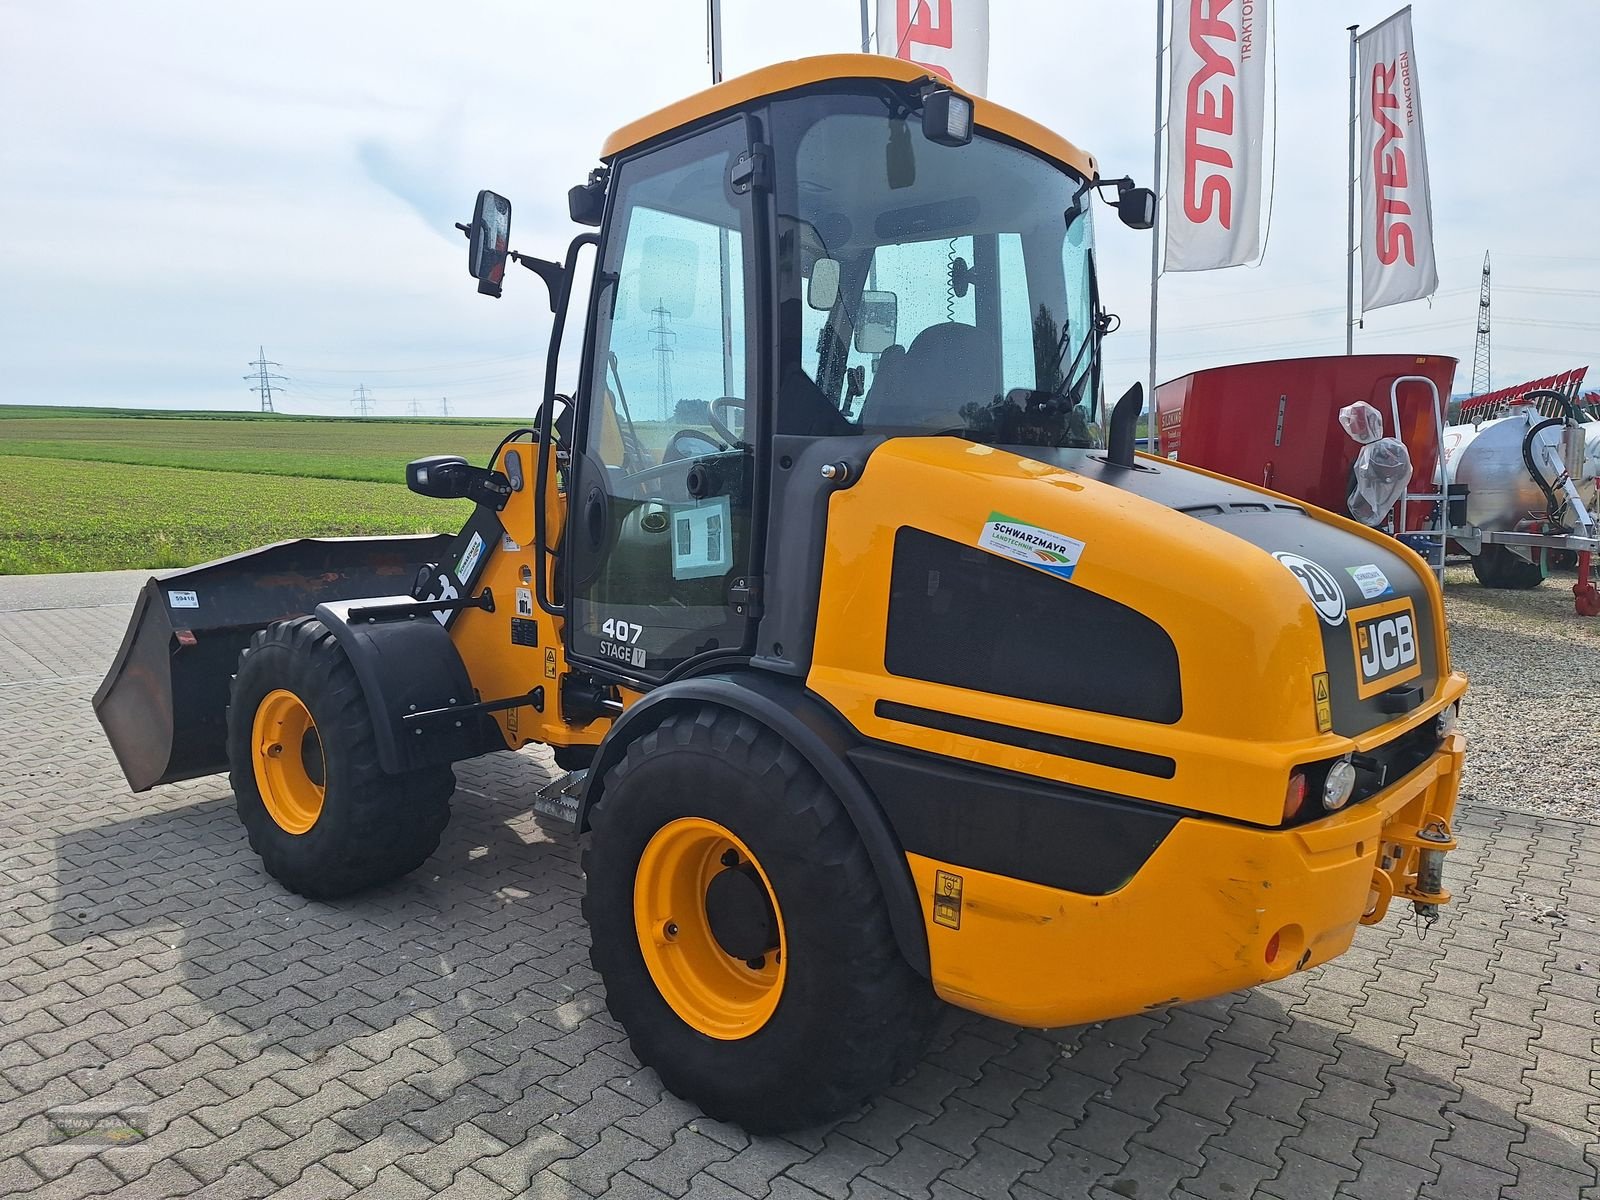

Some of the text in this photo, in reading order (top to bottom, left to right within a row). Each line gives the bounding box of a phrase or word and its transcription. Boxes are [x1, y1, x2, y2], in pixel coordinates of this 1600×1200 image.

[1399, 50, 1413, 126] TRAKTOREN
[1372, 60, 1415, 267] STEYR
[992, 532, 1034, 552] LANDTECHNIK
[993, 522, 1067, 555] SCHWARZMAYR
[1289, 563, 1338, 603] 20
[602, 617, 643, 645] 407
[1361, 615, 1416, 677] JCB
[600, 640, 646, 668] STAGE V
